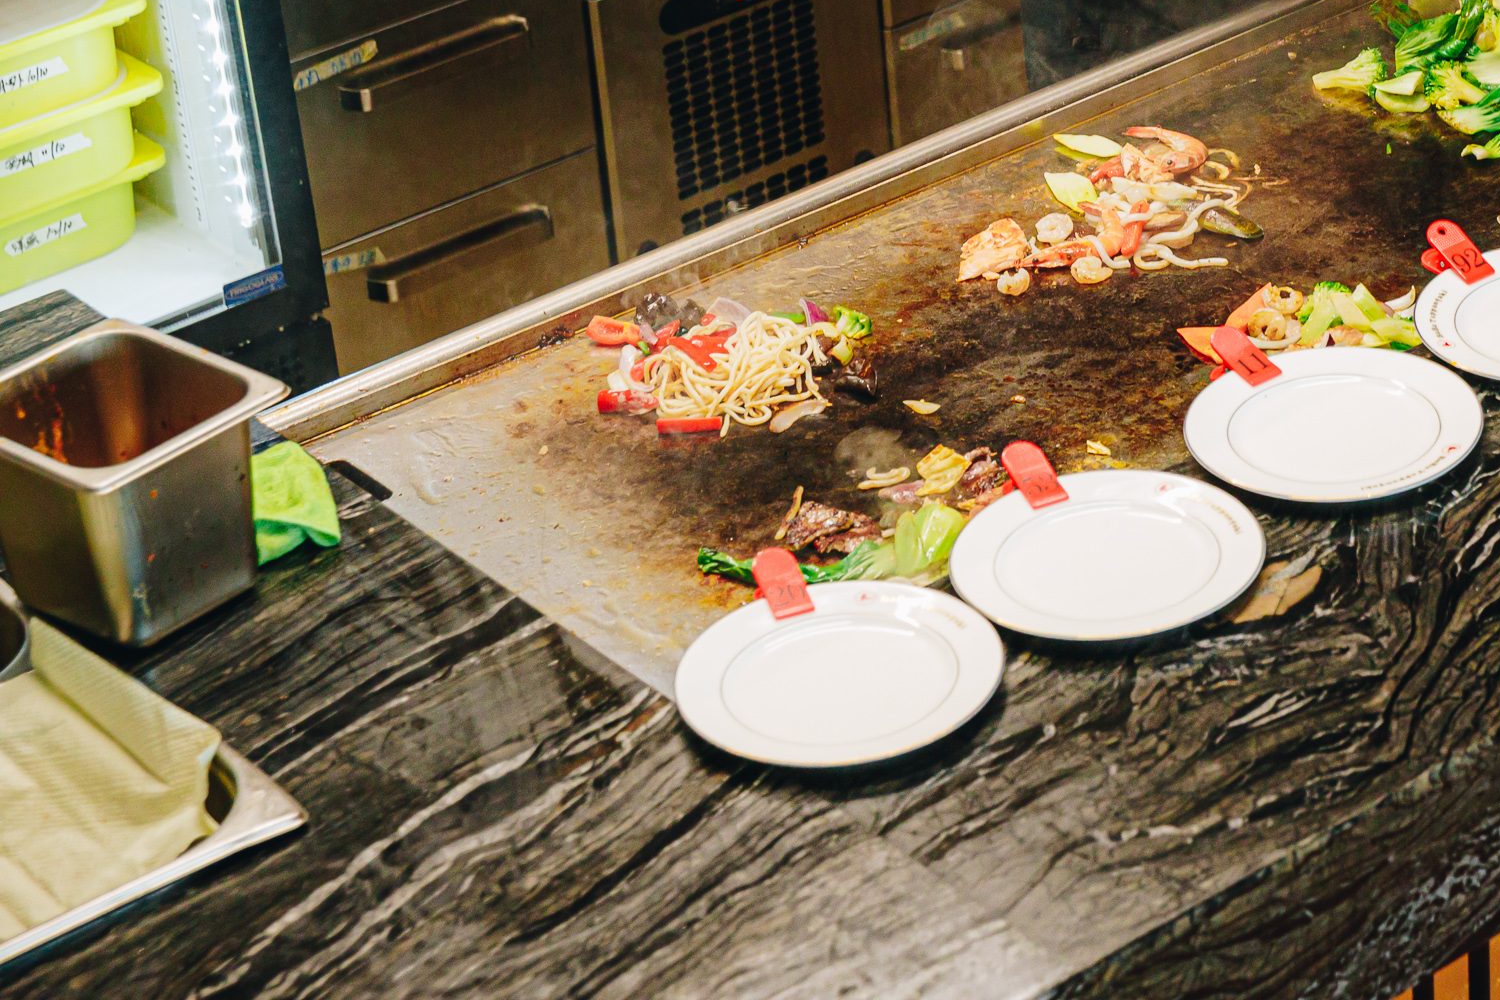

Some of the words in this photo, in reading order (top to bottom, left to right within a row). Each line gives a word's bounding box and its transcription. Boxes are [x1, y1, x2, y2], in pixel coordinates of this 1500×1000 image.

[1451, 247, 1486, 273] 92
[1237, 352, 1269, 376] 11
[768, 583, 806, 608] 20
